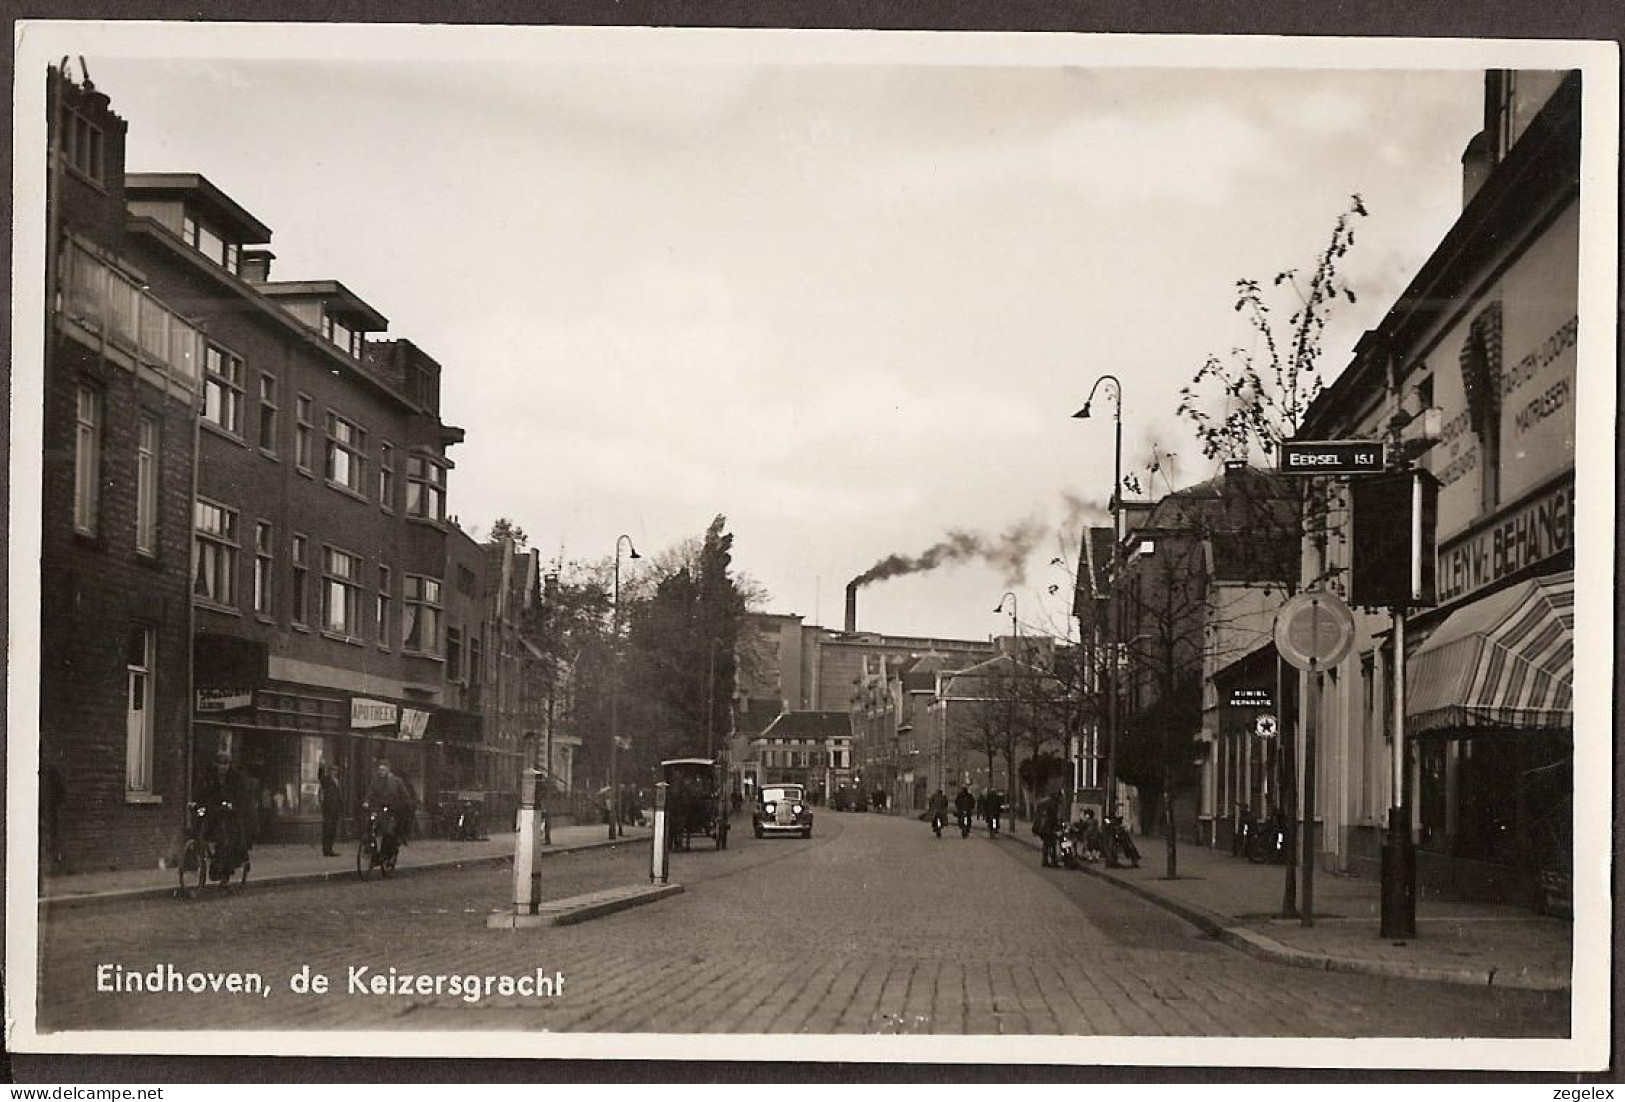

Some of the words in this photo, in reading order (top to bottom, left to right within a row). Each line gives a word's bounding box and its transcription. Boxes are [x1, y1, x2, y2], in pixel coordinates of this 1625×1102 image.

[1289, 452, 1343, 466] EERSEL
[1437, 544, 1471, 604] LLEN
[353, 703, 396, 721] APOTHEEK
